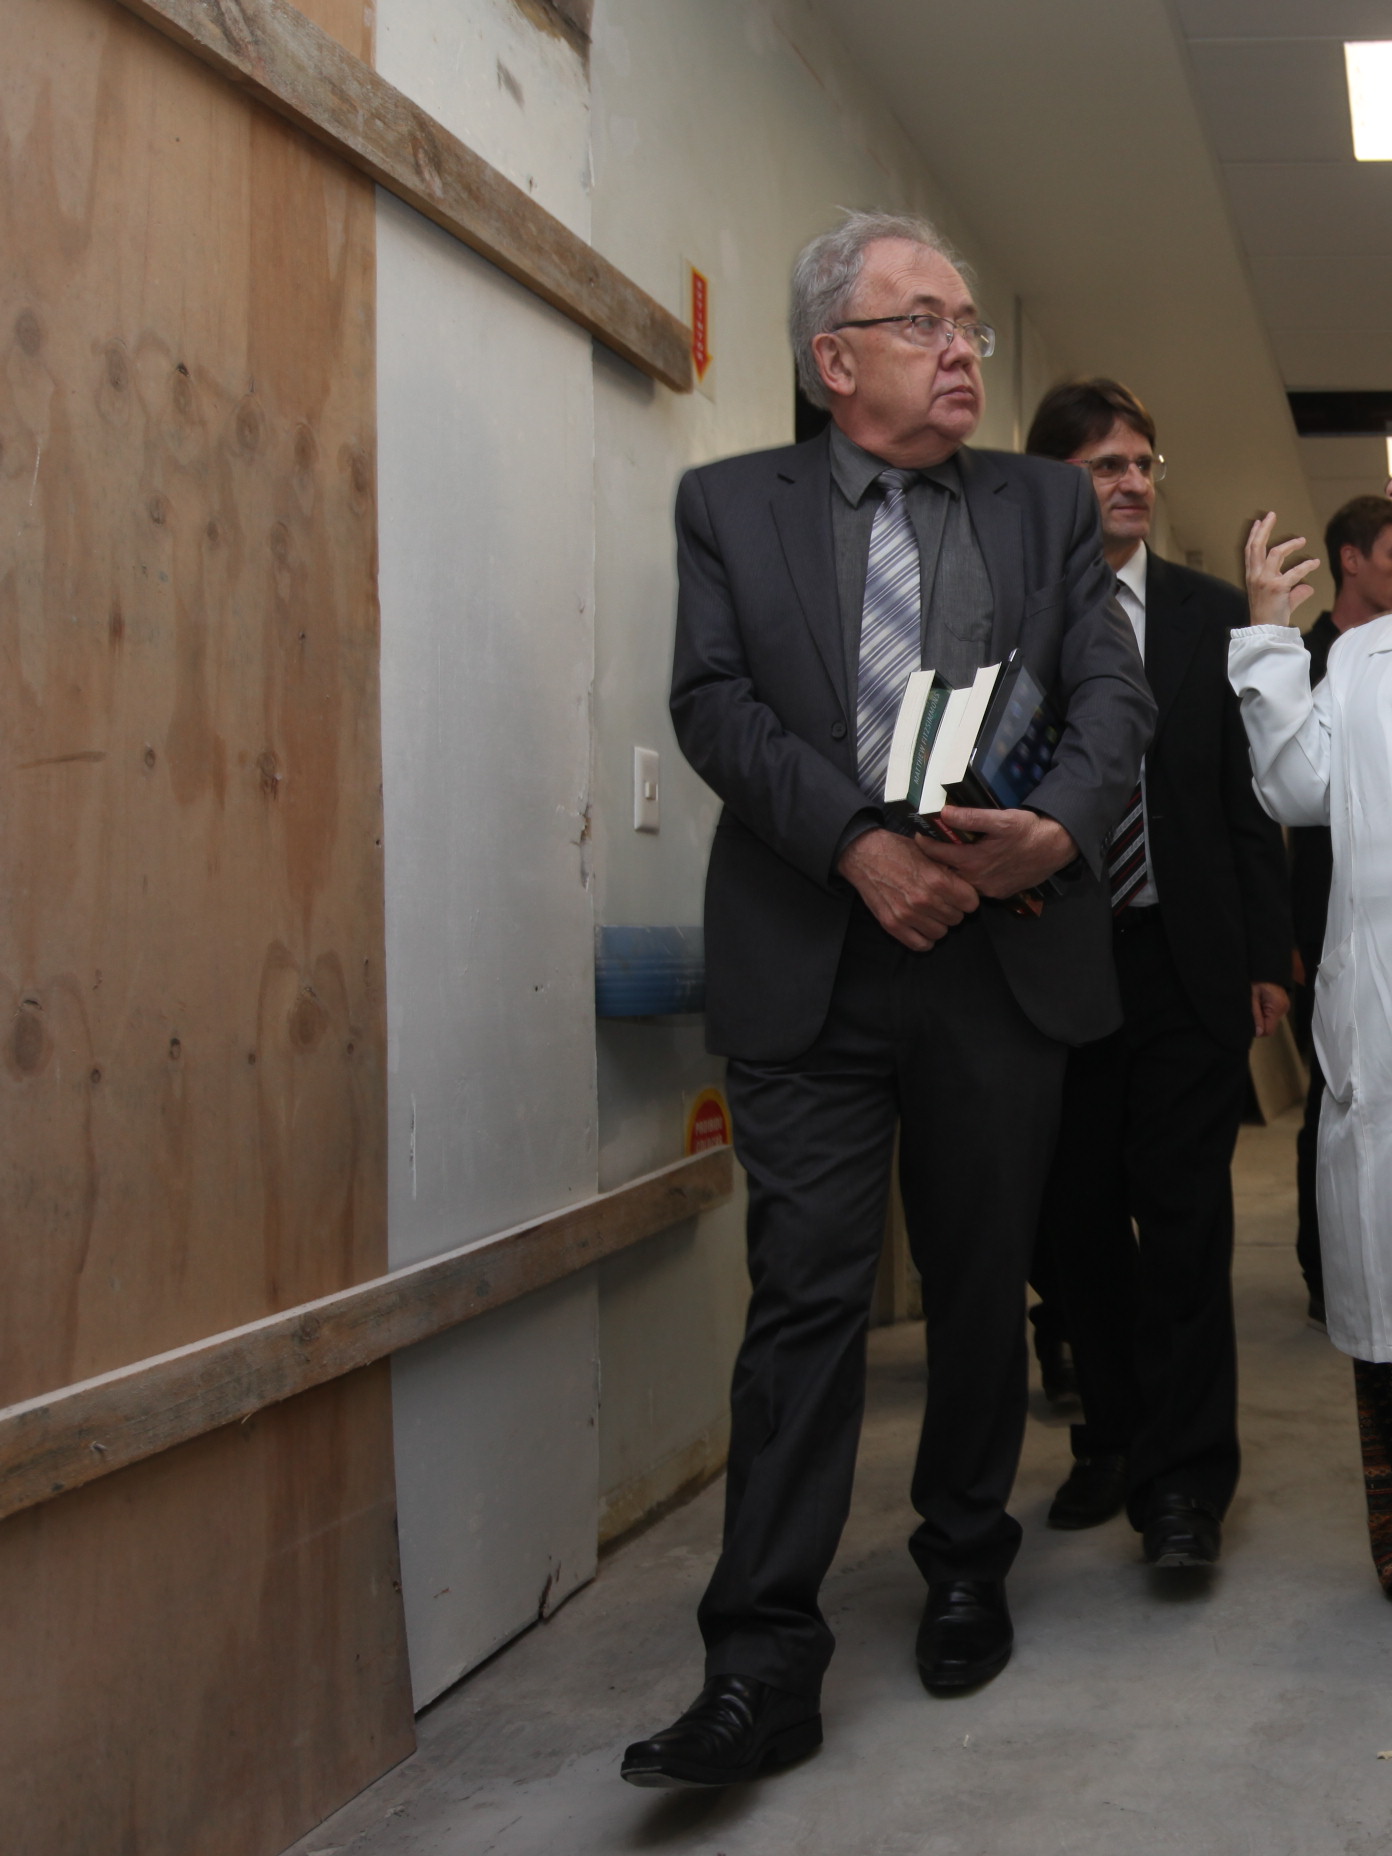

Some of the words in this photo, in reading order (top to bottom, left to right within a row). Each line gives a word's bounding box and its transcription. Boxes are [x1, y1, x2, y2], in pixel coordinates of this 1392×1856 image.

[695, 279, 705, 362] EXTINTOR
[913, 744, 926, 785] MATTHEW
[921, 692, 941, 745] FITZSIMMONS
[695, 1116, 723, 1137] PROIBIDO
